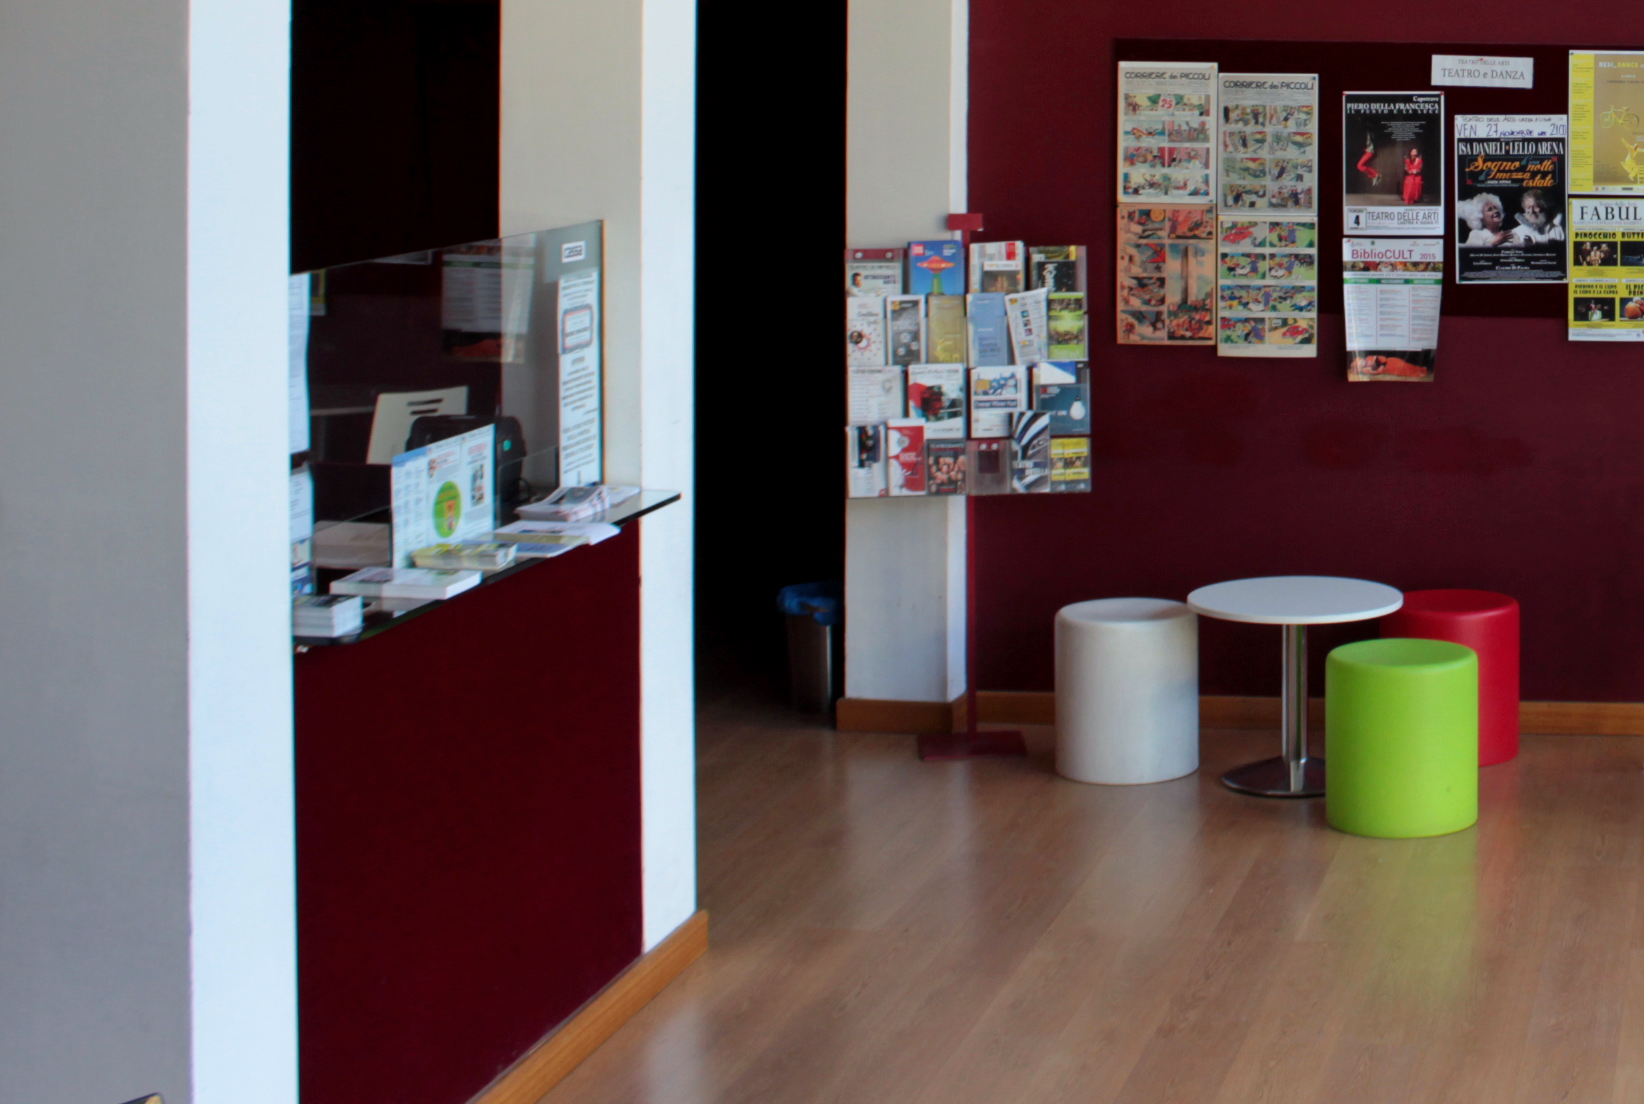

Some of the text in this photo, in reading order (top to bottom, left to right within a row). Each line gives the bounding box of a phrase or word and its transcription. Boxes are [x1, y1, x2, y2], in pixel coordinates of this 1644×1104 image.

[1124, 71, 1167, 80] CORRIERE
[1179, 72, 1211, 81] PICCOLI
[1441, 68, 1480, 78] TEATRO
[1491, 69, 1525, 80] DANZA
[1223, 80, 1268, 90] CORRIERE
[1280, 81, 1314, 91] PICCOLI
[1160, 98, 1175, 109] 25
[1346, 102, 1439, 110] PIERO DELLA FRANCESCA
[1486, 123, 1498, 137] 27
[1458, 141, 1564, 155] ISA DANIELI LELLO ARENA
[1465, 154, 1520, 179] Sogno
[1526, 158, 1555, 172] notte
[1522, 173, 1555, 187] estate
[1354, 214, 1360, 226] 4
[1367, 211, 1439, 221] TEATRO DELLE ARTI
[1351, 249, 1414, 259] BiblioCULT
